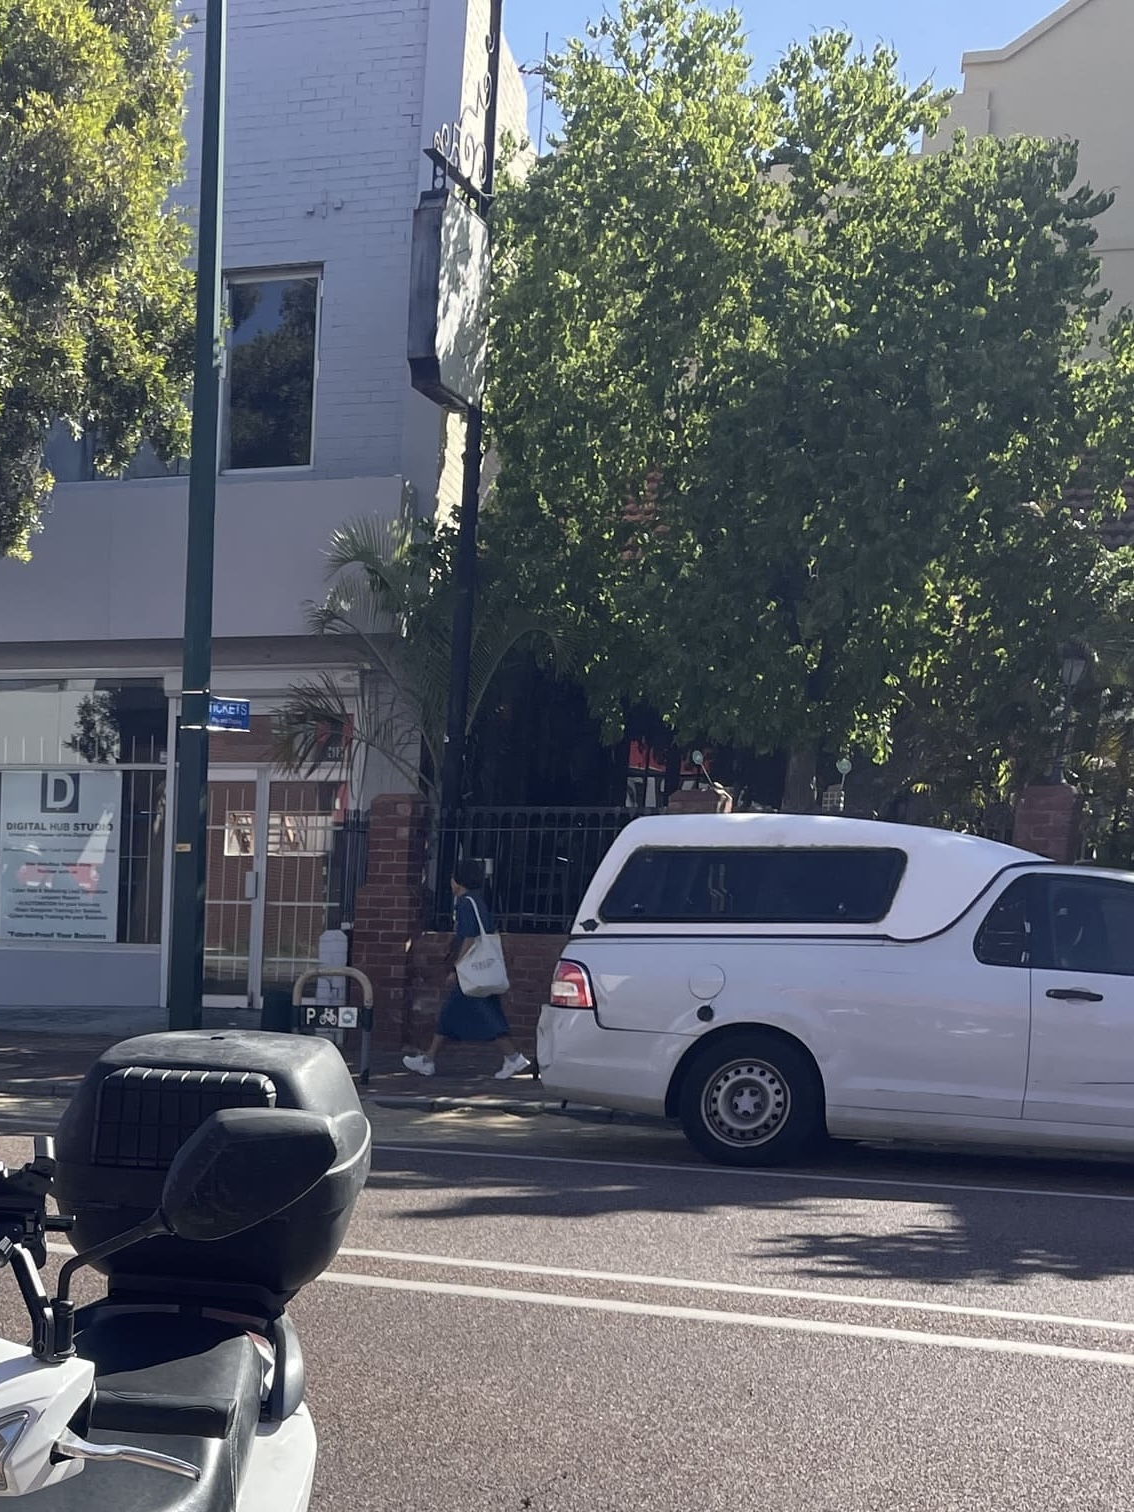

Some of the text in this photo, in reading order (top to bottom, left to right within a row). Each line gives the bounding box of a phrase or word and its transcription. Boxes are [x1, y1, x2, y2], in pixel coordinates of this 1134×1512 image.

[208, 701, 247, 716] TICKETS
[46, 770, 75, 809] D
[6, 821, 114, 832] DIGITAL HUB STUDIO
[306, 1007, 316, 1025] P
